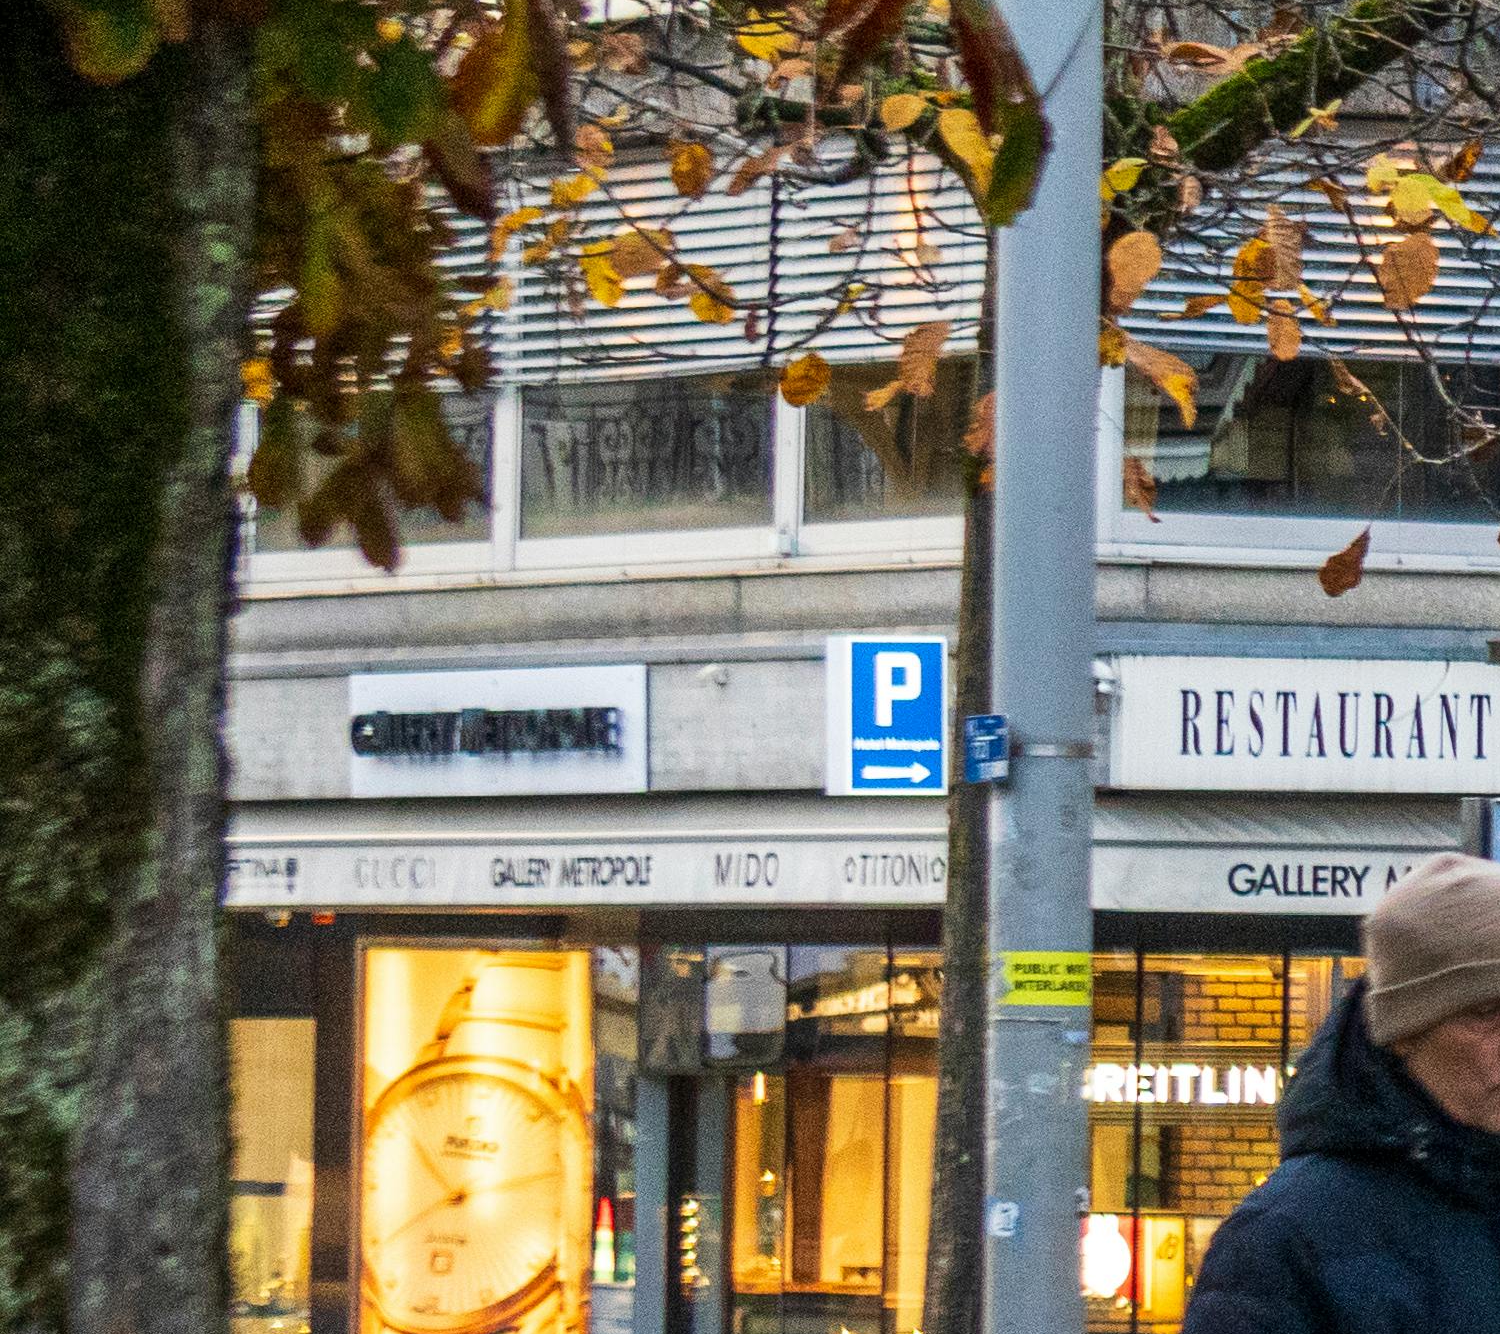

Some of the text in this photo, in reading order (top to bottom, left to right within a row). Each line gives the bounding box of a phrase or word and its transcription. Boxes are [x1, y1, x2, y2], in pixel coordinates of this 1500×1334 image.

[874, 650, 922, 728] P
[1180, 689, 1492, 760] RESTAURANT
[491, 854, 653, 889] GALLERY METROPOLE
[714, 851, 780, 888] MIDO
[858, 853, 930, 886] TITONI
[1228, 863, 1372, 898] GALLERY
[1082, 1063, 1286, 1105] REITLIN
